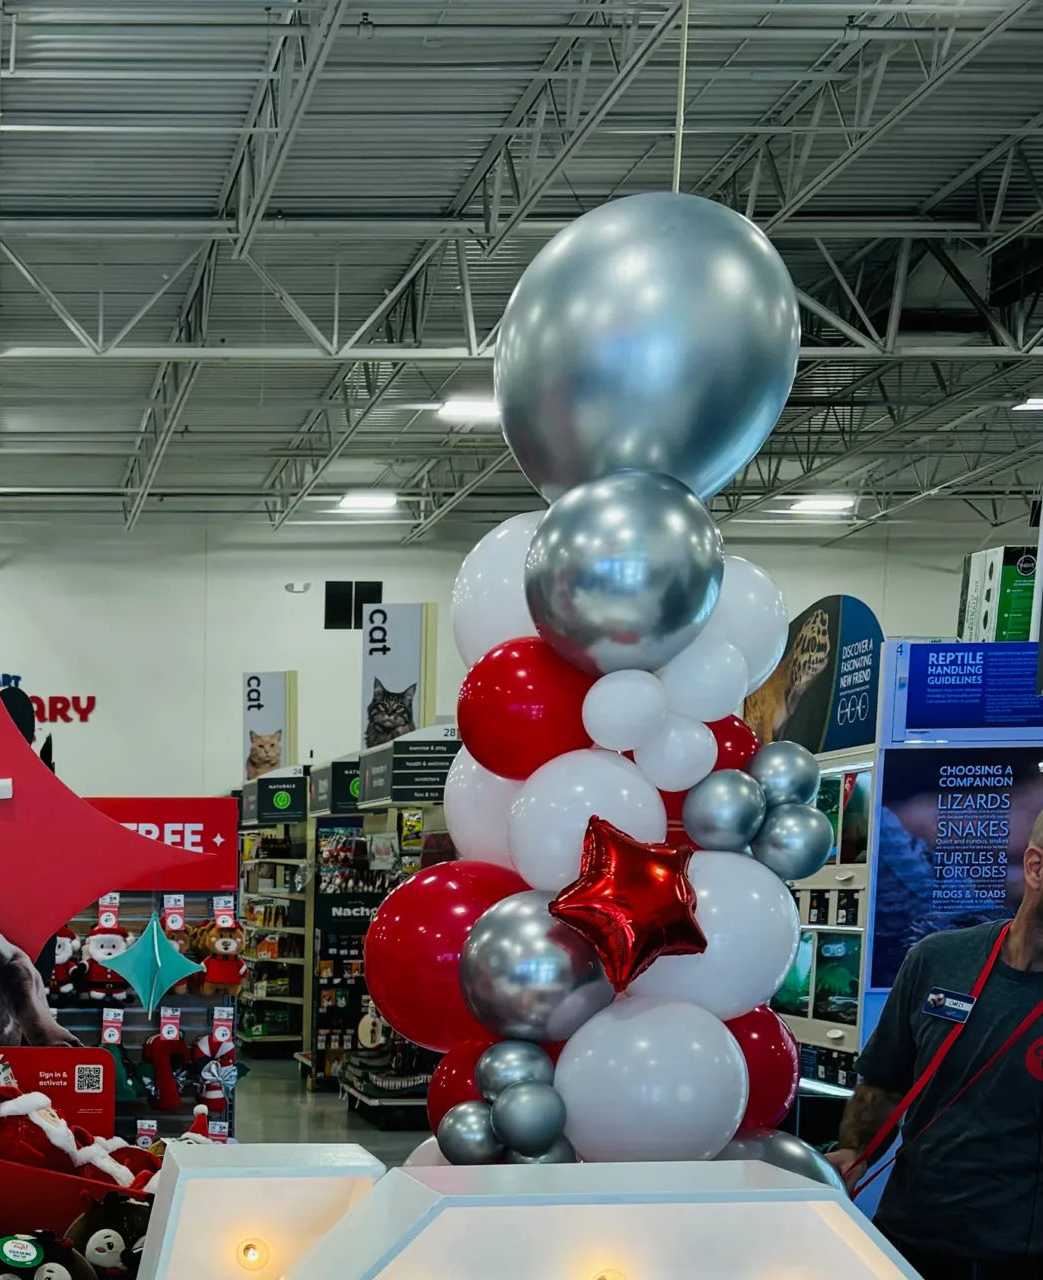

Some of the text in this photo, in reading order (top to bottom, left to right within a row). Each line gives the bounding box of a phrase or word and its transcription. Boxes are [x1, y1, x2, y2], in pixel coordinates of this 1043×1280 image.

[369, 608, 391, 656] cat
[842, 639, 868, 660] DISCOVER
[841, 654, 872, 673] FASCINATING
[928, 652, 984, 665] REPTILE
[927, 665, 983, 675] HANDLING
[840, 668, 871, 689] NEW FRIEND
[927, 676, 982, 685] GUIDELINES
[247, 675, 264, 711] cat
[443, 728, 456, 737] 28
[939, 765, 1013, 776] CHOOSING A
[939, 777, 1013, 787] COMPANION
[938, 793, 1011, 809] LIZARDS
[937, 820, 1009, 837] SNAKES
[934, 851, 1008, 865] TURTLES &
[934, 866, 1006, 878] TORTOISES
[932, 890, 1006, 899] FROGS & TOADS
[39, 1071, 54, 1079] Sign
